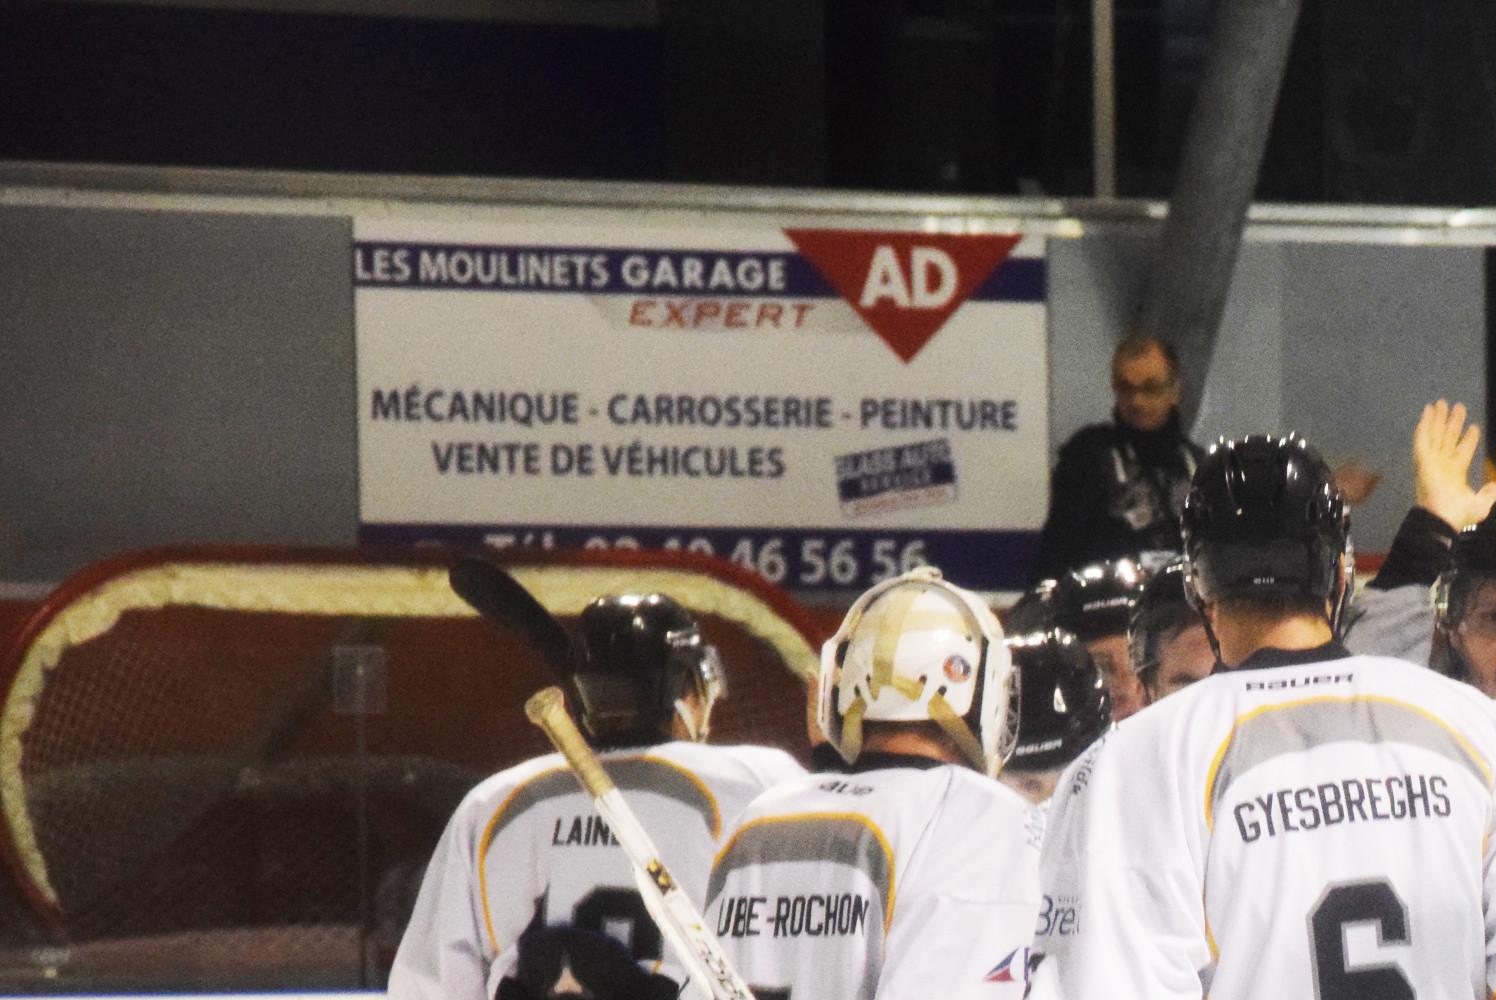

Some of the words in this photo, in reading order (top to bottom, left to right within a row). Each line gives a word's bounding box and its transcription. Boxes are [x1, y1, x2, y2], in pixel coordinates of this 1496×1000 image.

[354, 247, 410, 282] LES
[418, 249, 608, 288] MOULINETS
[621, 254, 786, 292] GARAGE
[859, 245, 958, 310] AD
[629, 298, 817, 329] EXPERT
[371, 384, 580, 428] MÉCANIQUE
[607, 393, 833, 430] CARROSSERIE
[859, 397, 1017, 431] PEINTURE
[432, 442, 540, 475] VENTE
[550, 444, 595, 476] DE
[602, 436, 786, 480] VÉHICULES
[800, 540, 858, 585] 56
[1233, 774, 1452, 844] GYESBREGHS
